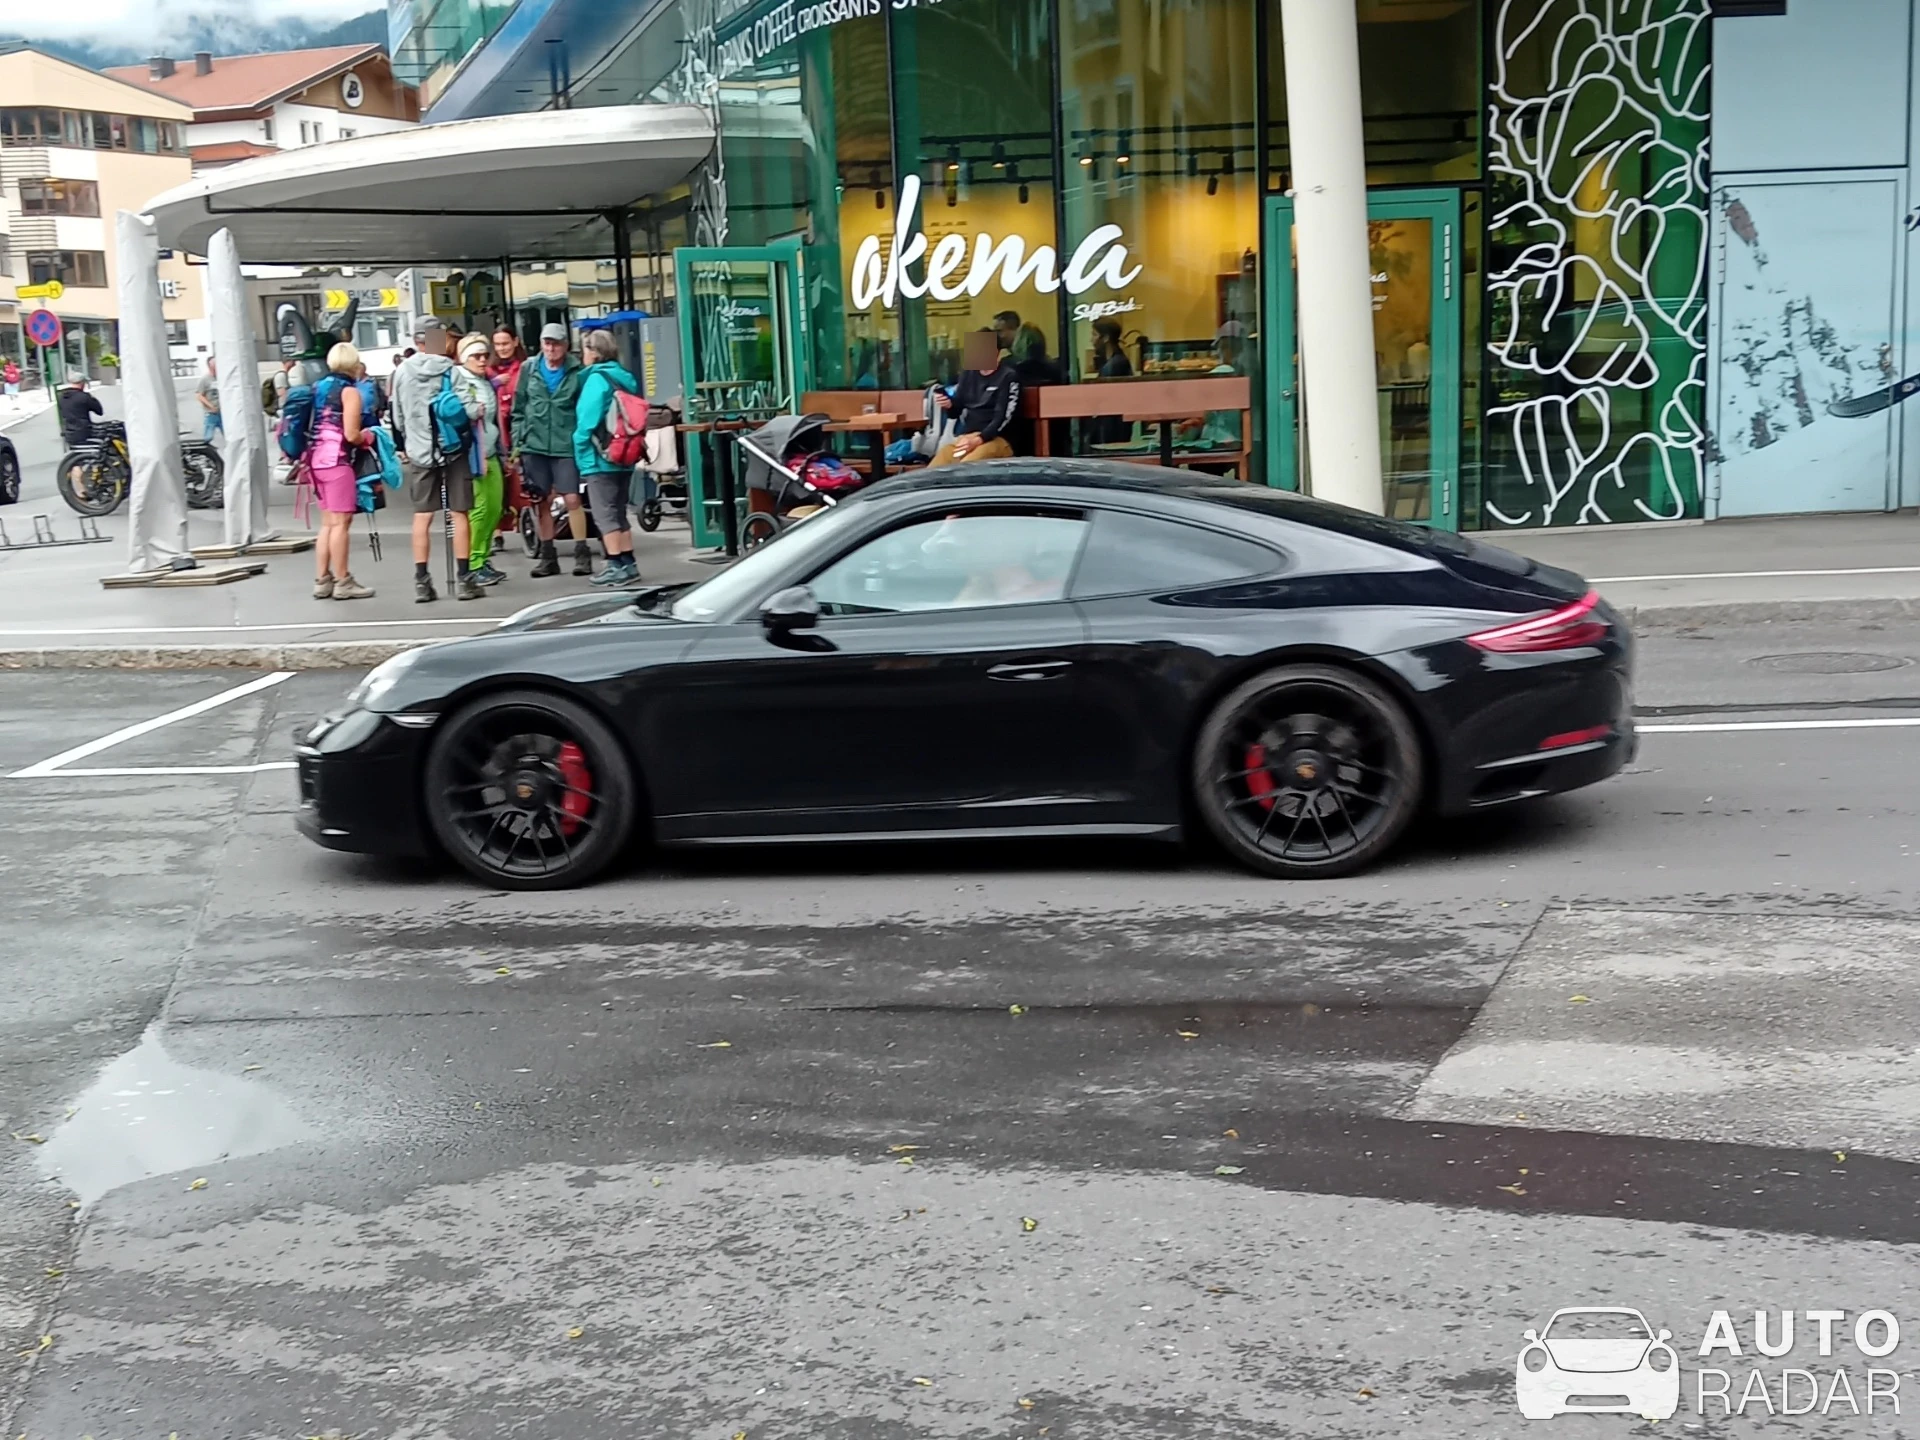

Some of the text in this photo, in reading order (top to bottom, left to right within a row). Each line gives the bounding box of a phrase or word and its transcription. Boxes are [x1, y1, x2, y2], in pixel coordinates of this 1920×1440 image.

[754, 0, 797, 58] COFFEE
[797, 0, 882, 33] CROISSANTS
[851, 174, 1144, 310] okema
[347, 288, 380, 300] BIKE
